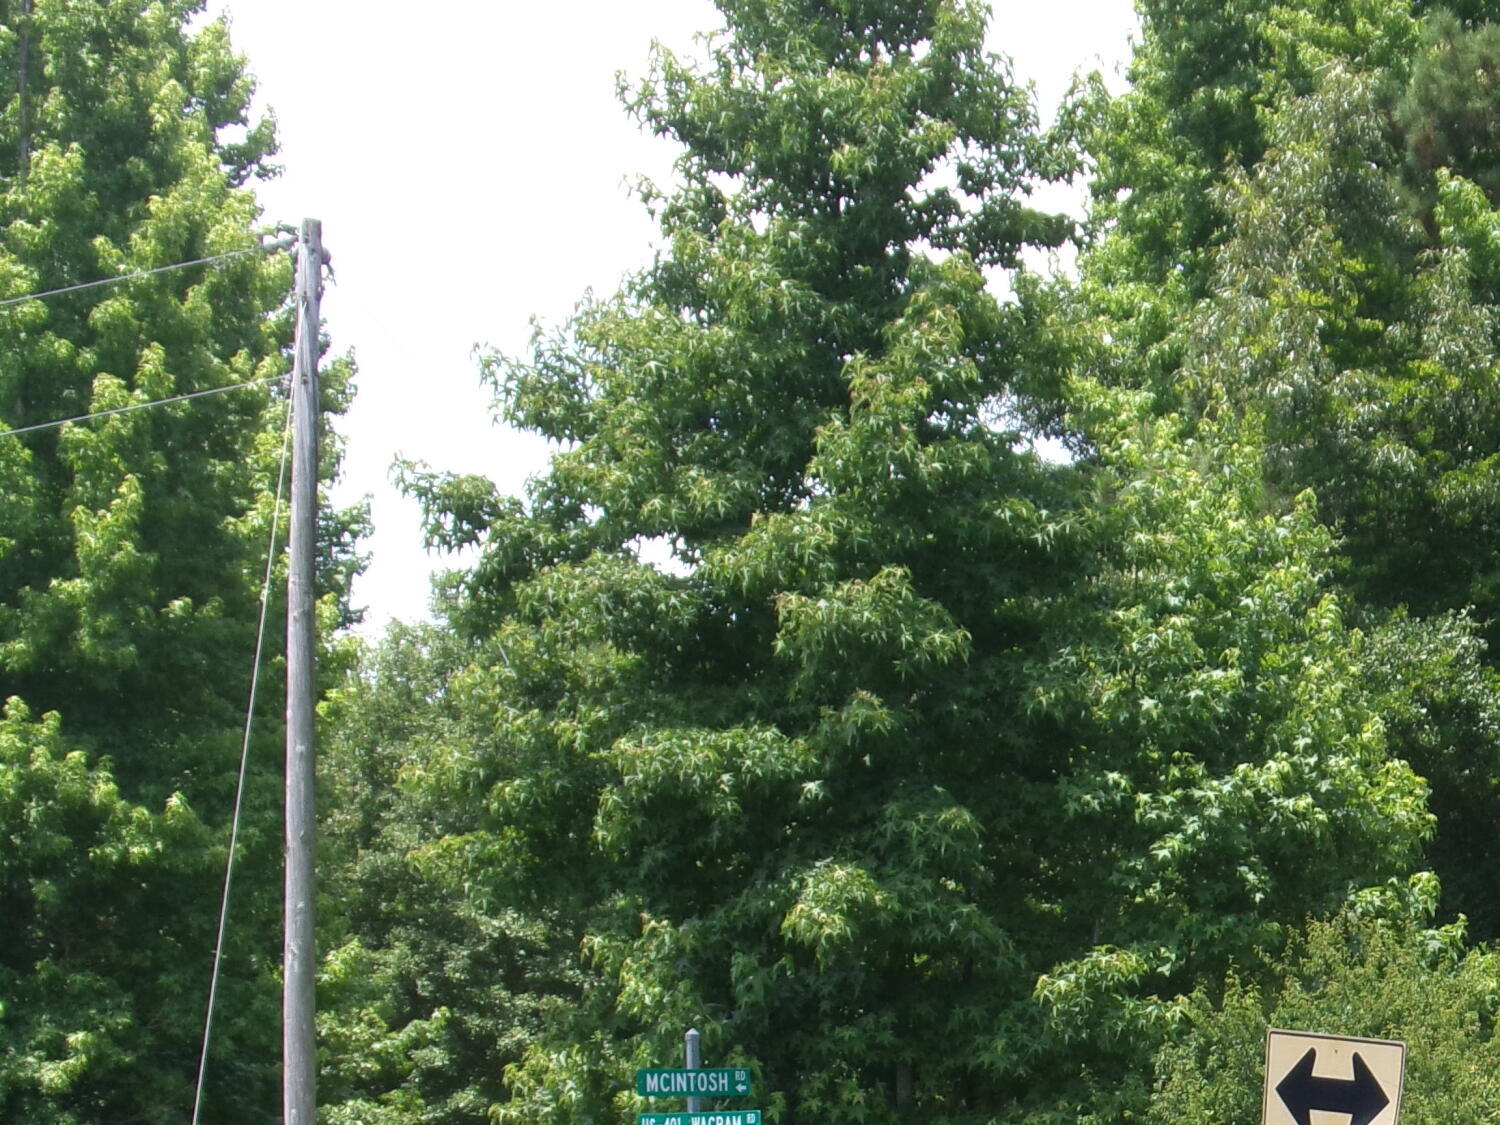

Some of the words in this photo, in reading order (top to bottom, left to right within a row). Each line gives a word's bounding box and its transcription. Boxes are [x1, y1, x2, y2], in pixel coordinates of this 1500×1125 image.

[646, 1072, 728, 1093] MCINTOSH
[735, 1070, 746, 1081] RD
[746, 1113, 756, 1124] RD
